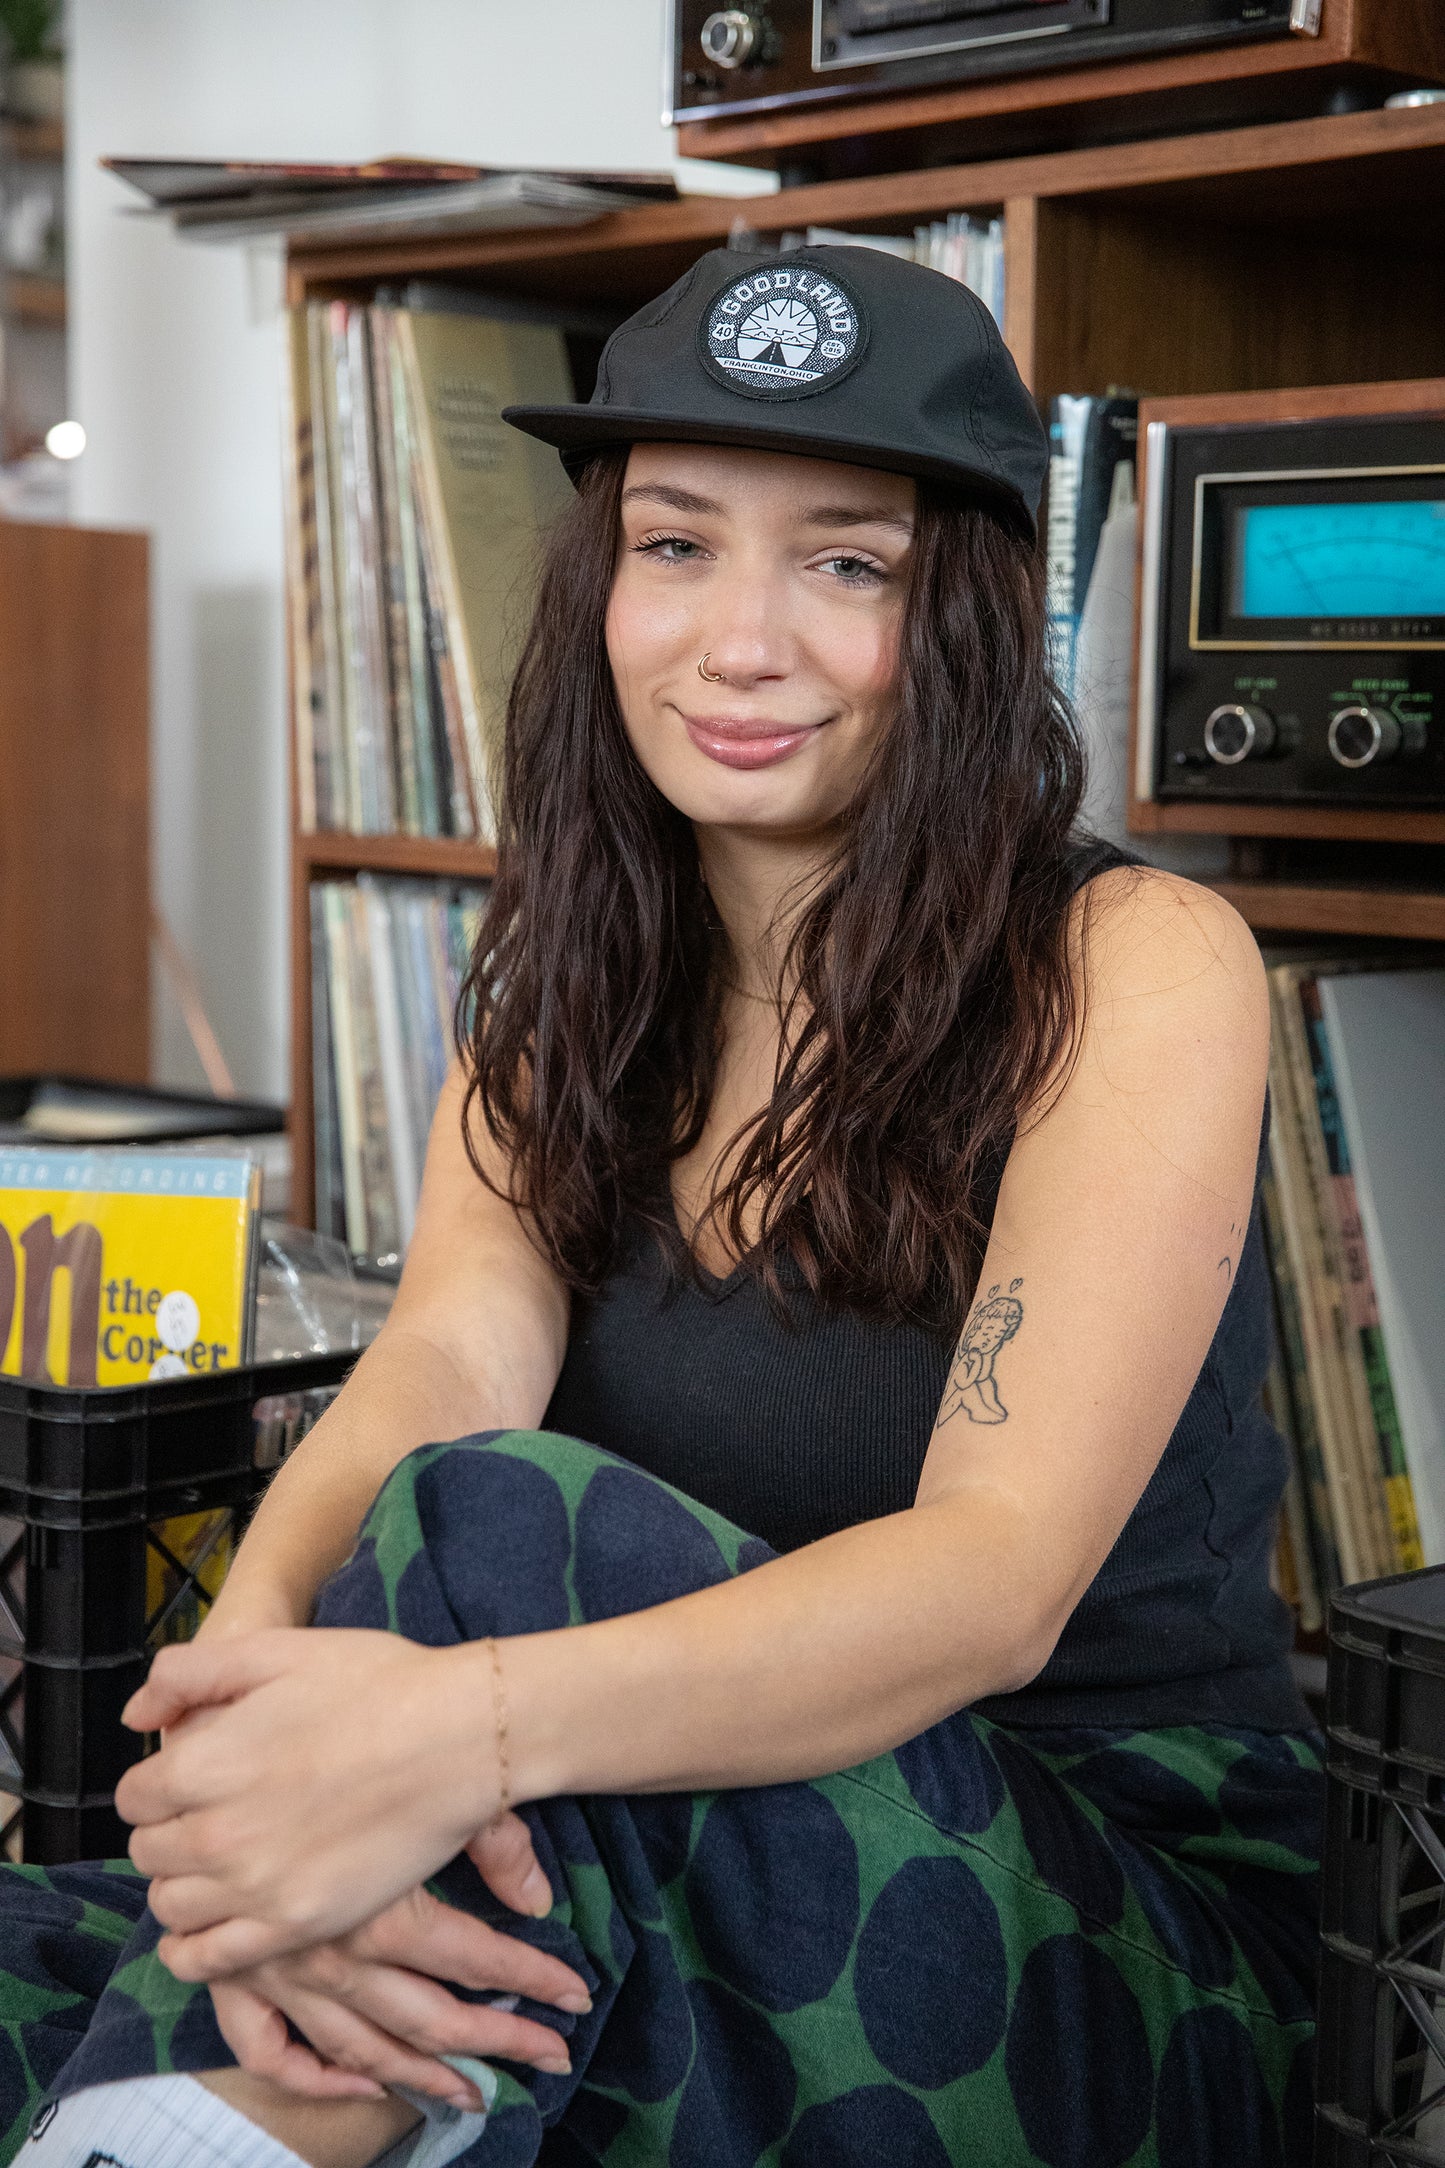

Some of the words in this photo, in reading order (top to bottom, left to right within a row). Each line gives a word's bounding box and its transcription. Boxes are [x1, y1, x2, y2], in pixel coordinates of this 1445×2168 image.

[721, 272, 851, 332] GOODLAND
[715, 326, 731, 338] 40
[826, 341, 842, 349] EST.
[823, 346, 842, 354] 2015
[64, 1165, 229, 1193] REORDING
[106, 1278, 162, 1314] the
[103, 1325, 228, 1371] Corer
